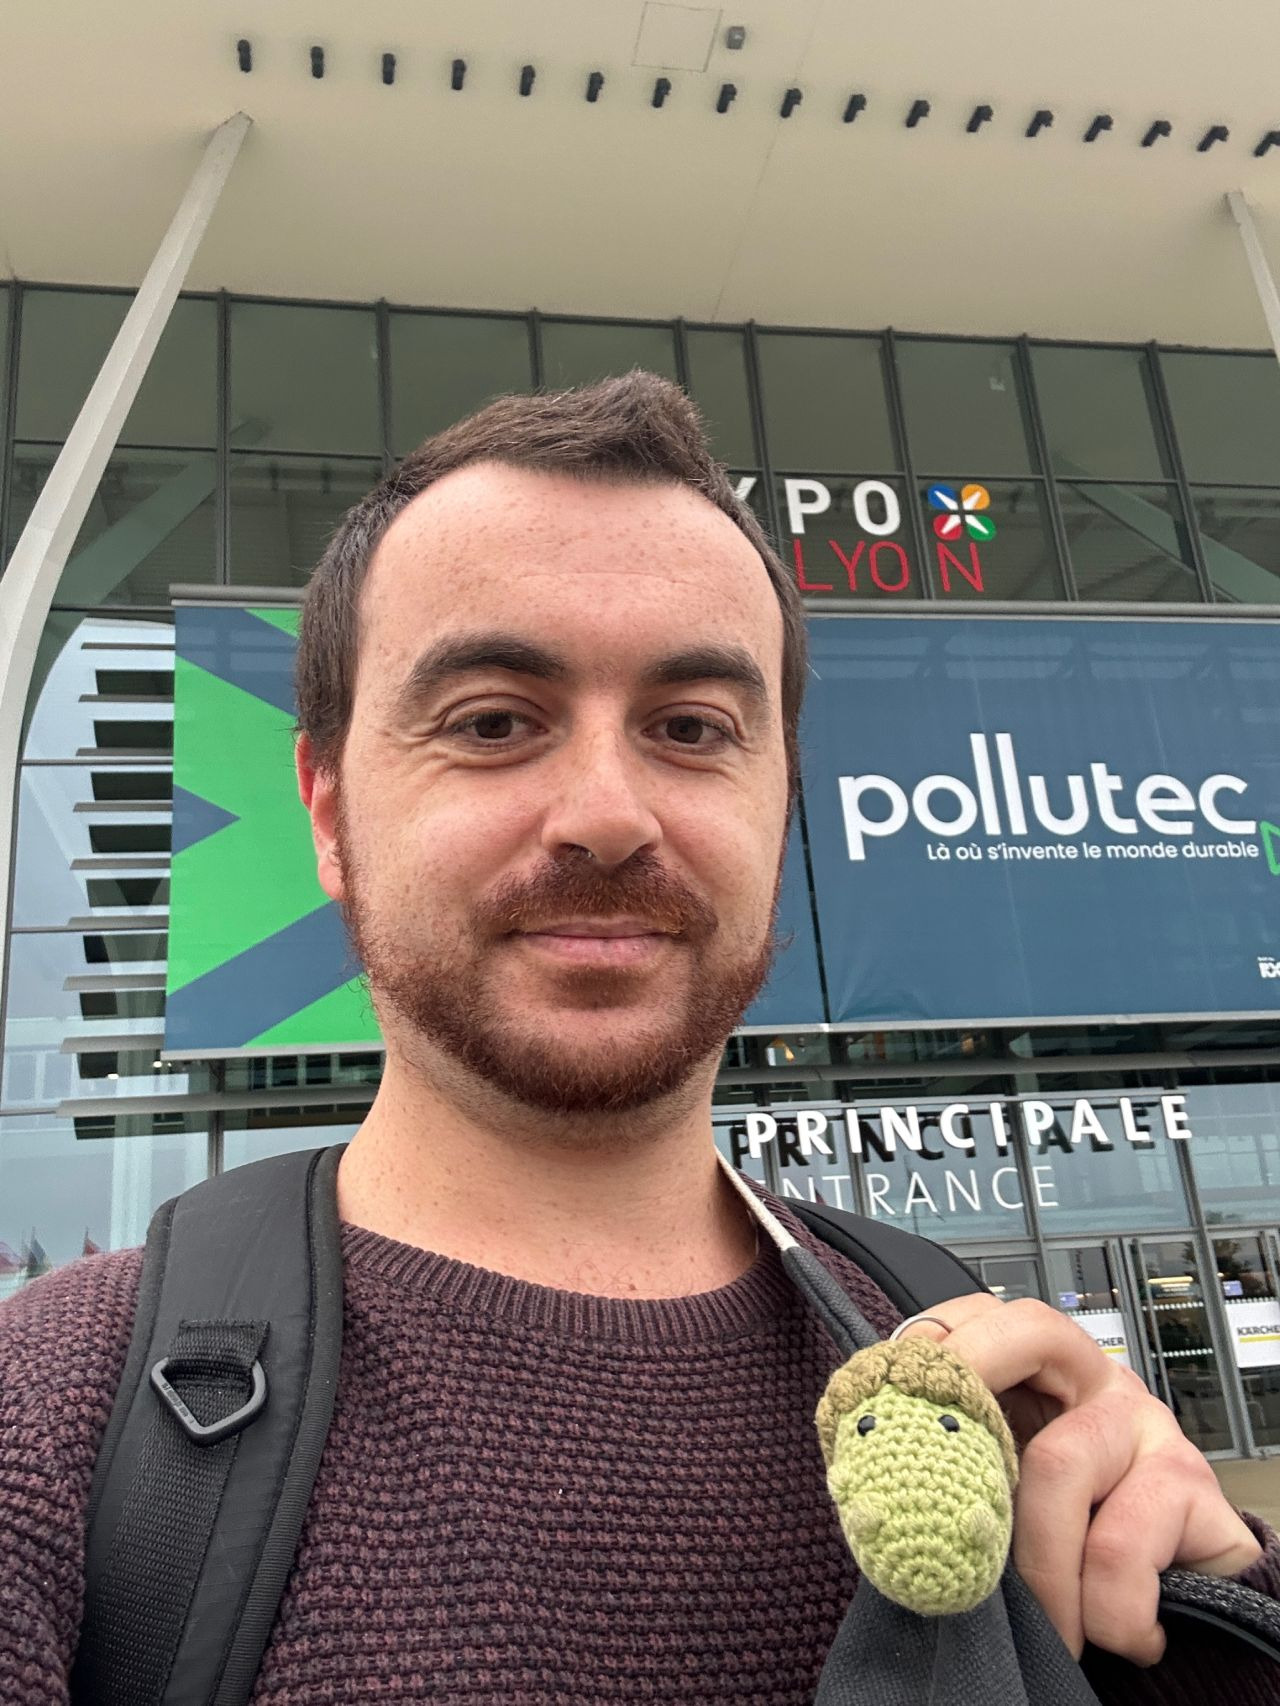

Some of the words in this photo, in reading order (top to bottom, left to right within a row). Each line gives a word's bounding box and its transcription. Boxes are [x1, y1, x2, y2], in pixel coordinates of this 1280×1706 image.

[734, 477, 902, 536] PO
[793, 539, 985, 592] LYON
[838, 733, 1257, 861] pollutec
[927, 843, 950, 860] Là
[955, 843, 982, 860] où
[1082, 842, 1102, 859] le
[1106, 841, 1178, 858] monde
[1182, 841, 1260, 858] durable
[746, 1095, 1193, 1158] PRINCIPALE
[757, 1165, 1060, 1216] NTRANCE
